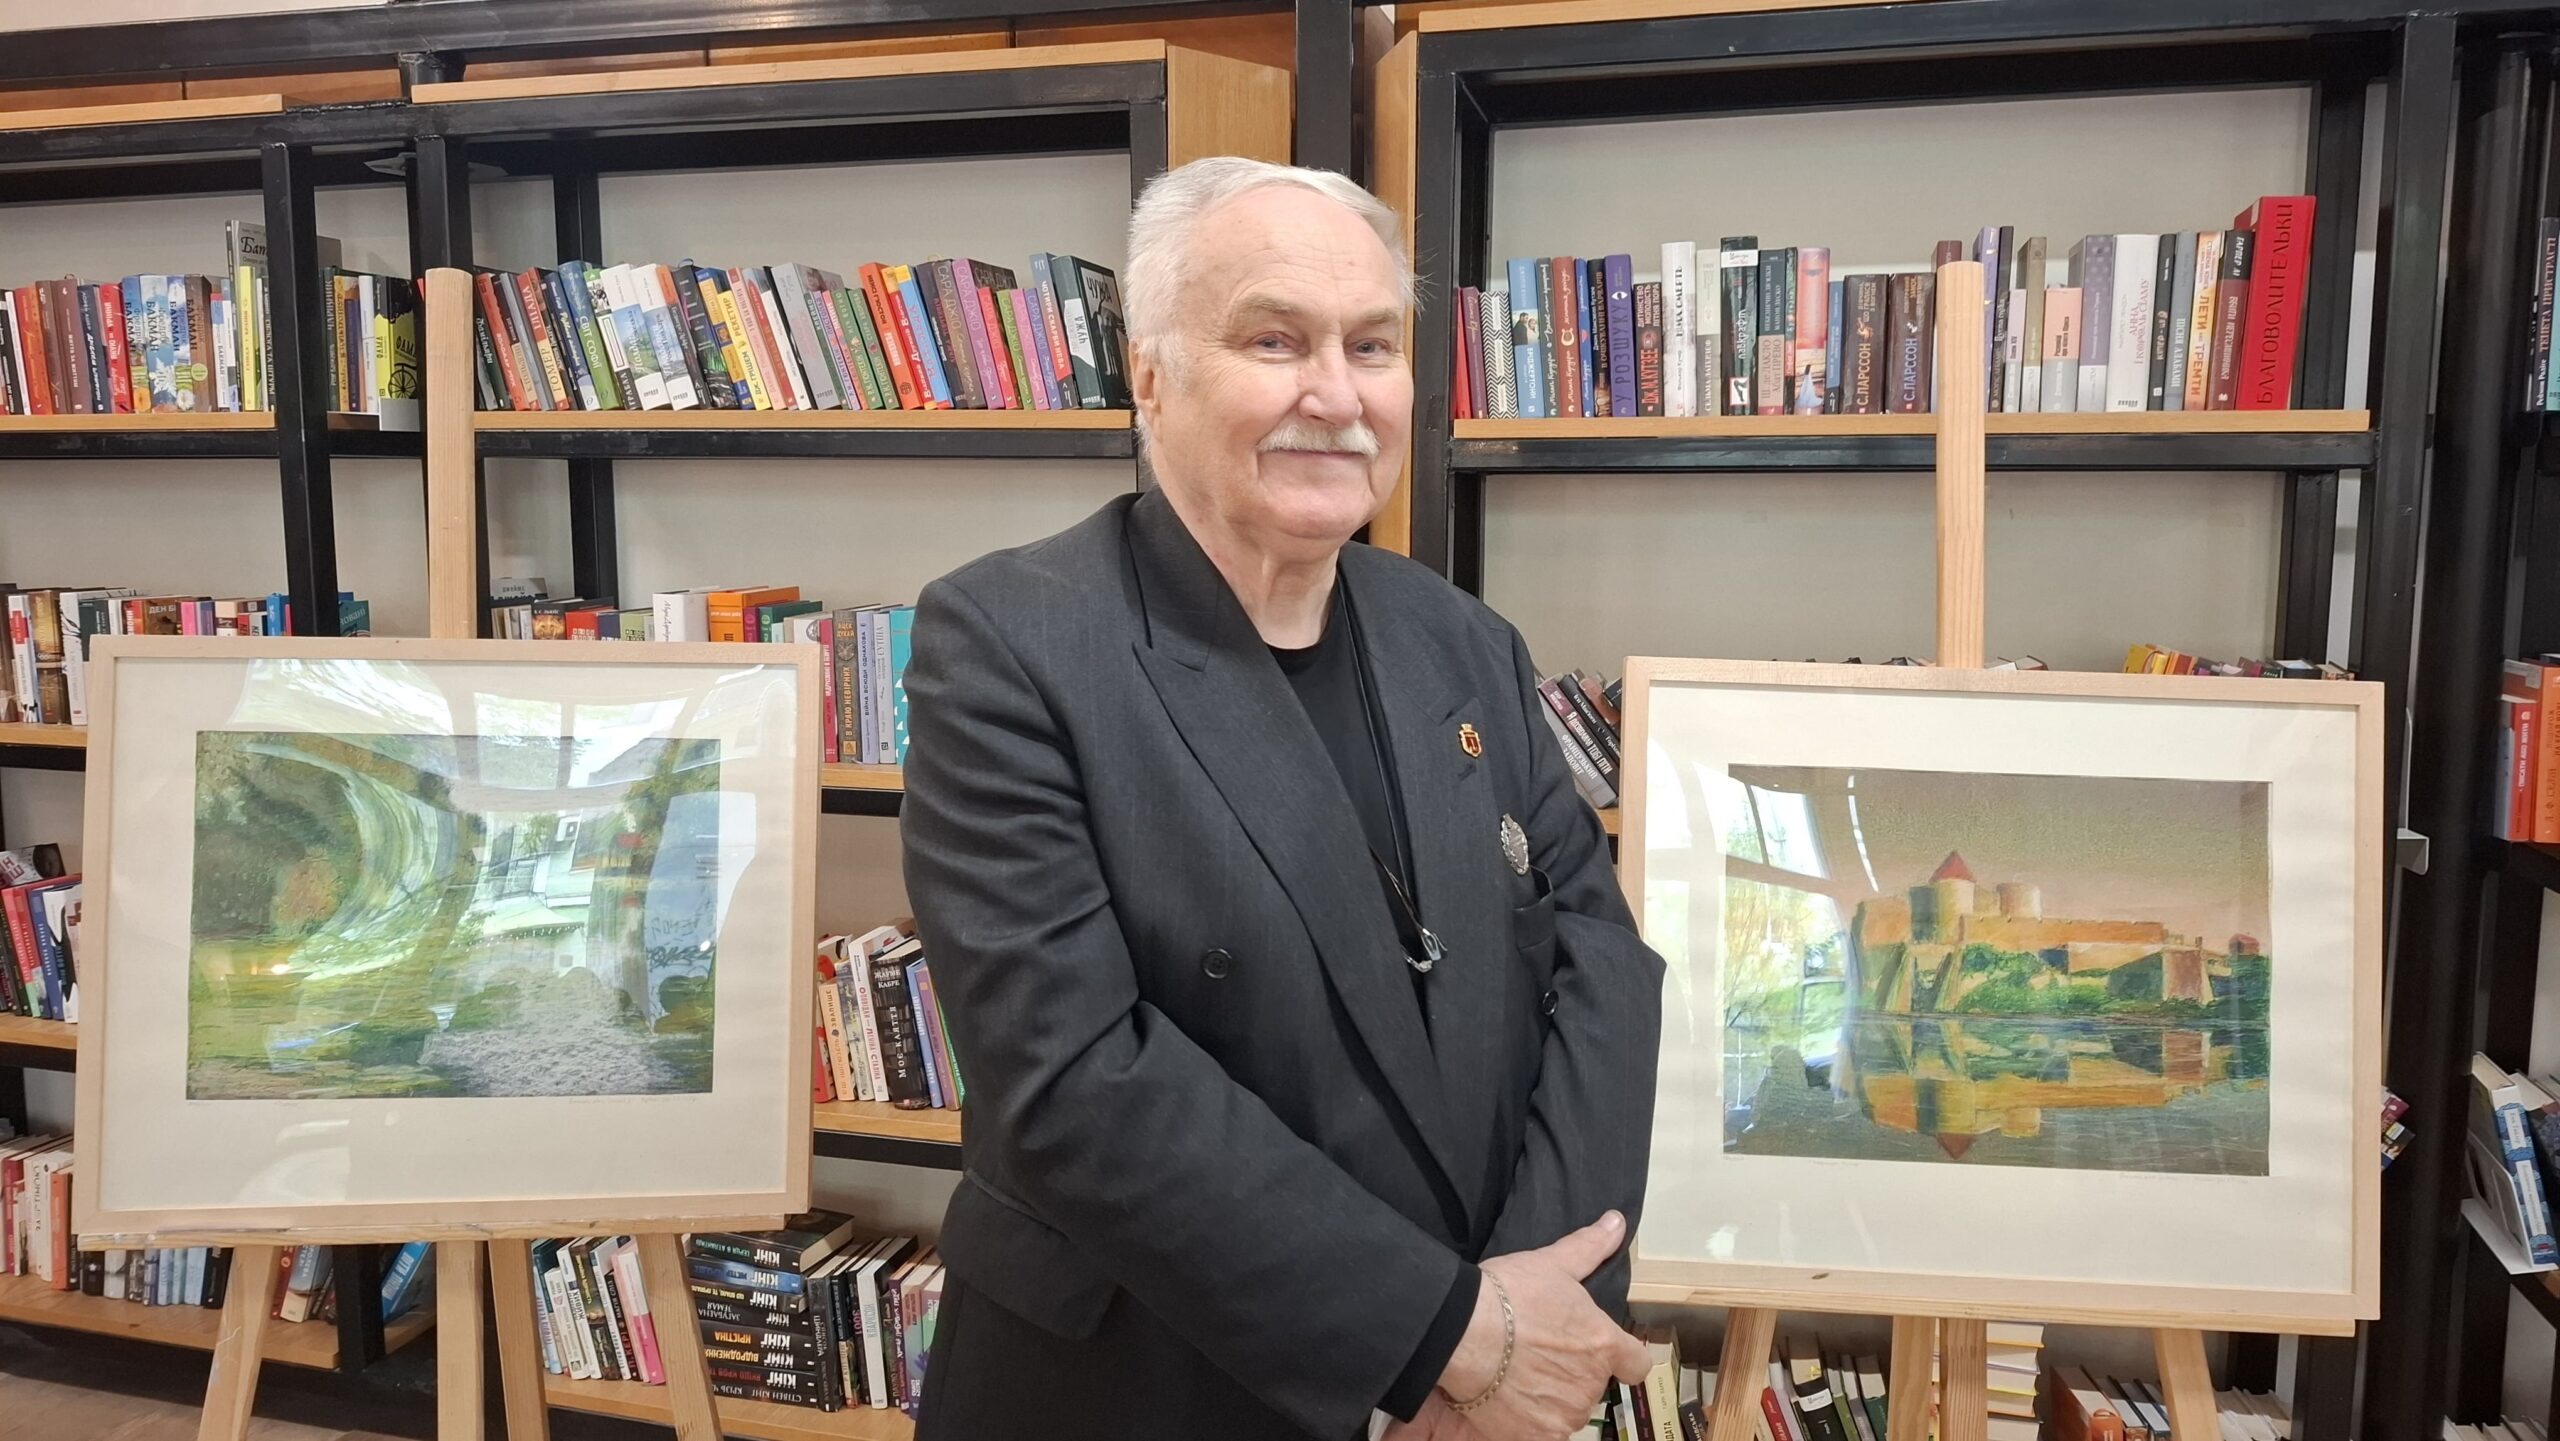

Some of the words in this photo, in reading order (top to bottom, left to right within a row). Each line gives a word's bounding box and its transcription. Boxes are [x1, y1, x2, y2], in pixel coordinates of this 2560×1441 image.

[2233, 237, 2245, 265] ГАРПЕР
[325, 280, 335, 330] ЧАРІВНИК
[937, 265, 952, 296] САРА
[946, 299, 962, 330] ДЖІО
[955, 266, 970, 297] САРА
[964, 299, 981, 331] ДЖІО
[1644, 284, 1652, 324] МОЛОДІСТЬ
[1674, 266, 1683, 308] СМЕРТЬ
[2256, 203, 2294, 405] БЛАГОВОЛИТЕЛЬКИ
[522, 285, 542, 330] ІЛІАДА
[723, 298, 741, 337] РЕКЕТИР
[1028, 295, 1040, 321] САРА
[1034, 324, 1047, 350] ДЖІО
[1637, 285, 1645, 327] ДИТИНСТВО
[2129, 306, 2138, 336] АННА
[2196, 295, 2209, 330] ЛЕТИ
[125, 301, 136, 353] БАКМАН
[146, 300, 158, 352] БАКМАН
[170, 301, 180, 352] БАКМАН
[187, 298, 197, 351] БАКМАН
[265, 319, 273, 350] ОБЛОГА
[580, 316, 592, 337] СВІТ
[587, 340, 602, 368] СОФІЇ
[1002, 298, 1012, 324] САРА
[1007, 326, 1021, 351] ДЖІО
[1041, 281, 1053, 313] ЧОТИРИ
[1048, 315, 1060, 347] СКАРБИ
[1055, 348, 1064, 369] НЕБА
[1074, 315, 1088, 344] ЧУЖА
[2174, 318, 2186, 344] ПІСНЯ
[2539, 309, 2552, 352] ТЕНЕТА
[217, 345, 225, 375] БАКМАН
[266, 352, 273, 363] ТА
[1612, 304, 1631, 384] РОЗШУКУ
[1762, 339, 1771, 376] ЛАКЛО
[1772, 339, 1781, 371] ПРЕВО
[266, 364, 275, 395] ШТУРМ
[540, 348, 562, 393] ГОМЕР
[742, 351, 757, 380] ГРІШЕМ
[1526, 347, 1537, 399] БРІДЖЕРТОНИ
[1640, 348, 1658, 378] КУТЗЕЕ
[2171, 347, 2182, 388] АЛАБАМИ
[2191, 344, 2205, 395] ТРЕМТИ
[751, 381, 762, 395] ДЖ.
[1615, 393, 1632, 402] У
[1773, 373, 1781, 393] Абат
[149, 605, 166, 614] ДЕН
[843, 666, 852, 705] НЕВІРНИХ
[844, 707, 853, 728] КРАЮ
[1587, 743, 1603, 762] ТОБІ
[878, 979, 900, 989] КАБРЕ
[698, 1308, 741, 1321] ЗАГУБЛЕНА
[706, 1302, 732, 1312] ЗЕМЛЯ
[851, 1309, 862, 1335] 3001
[715, 1331, 751, 1344] КРІСТІНА
[813, 1315, 824, 1356] ШИНДЛЕРА
[704, 1349, 759, 1363] ВІДРОДЖЕННЯ
[720, 1385, 743, 1395] КРІЗЬ
[772, 1391, 802, 1403] СТІВЕН
